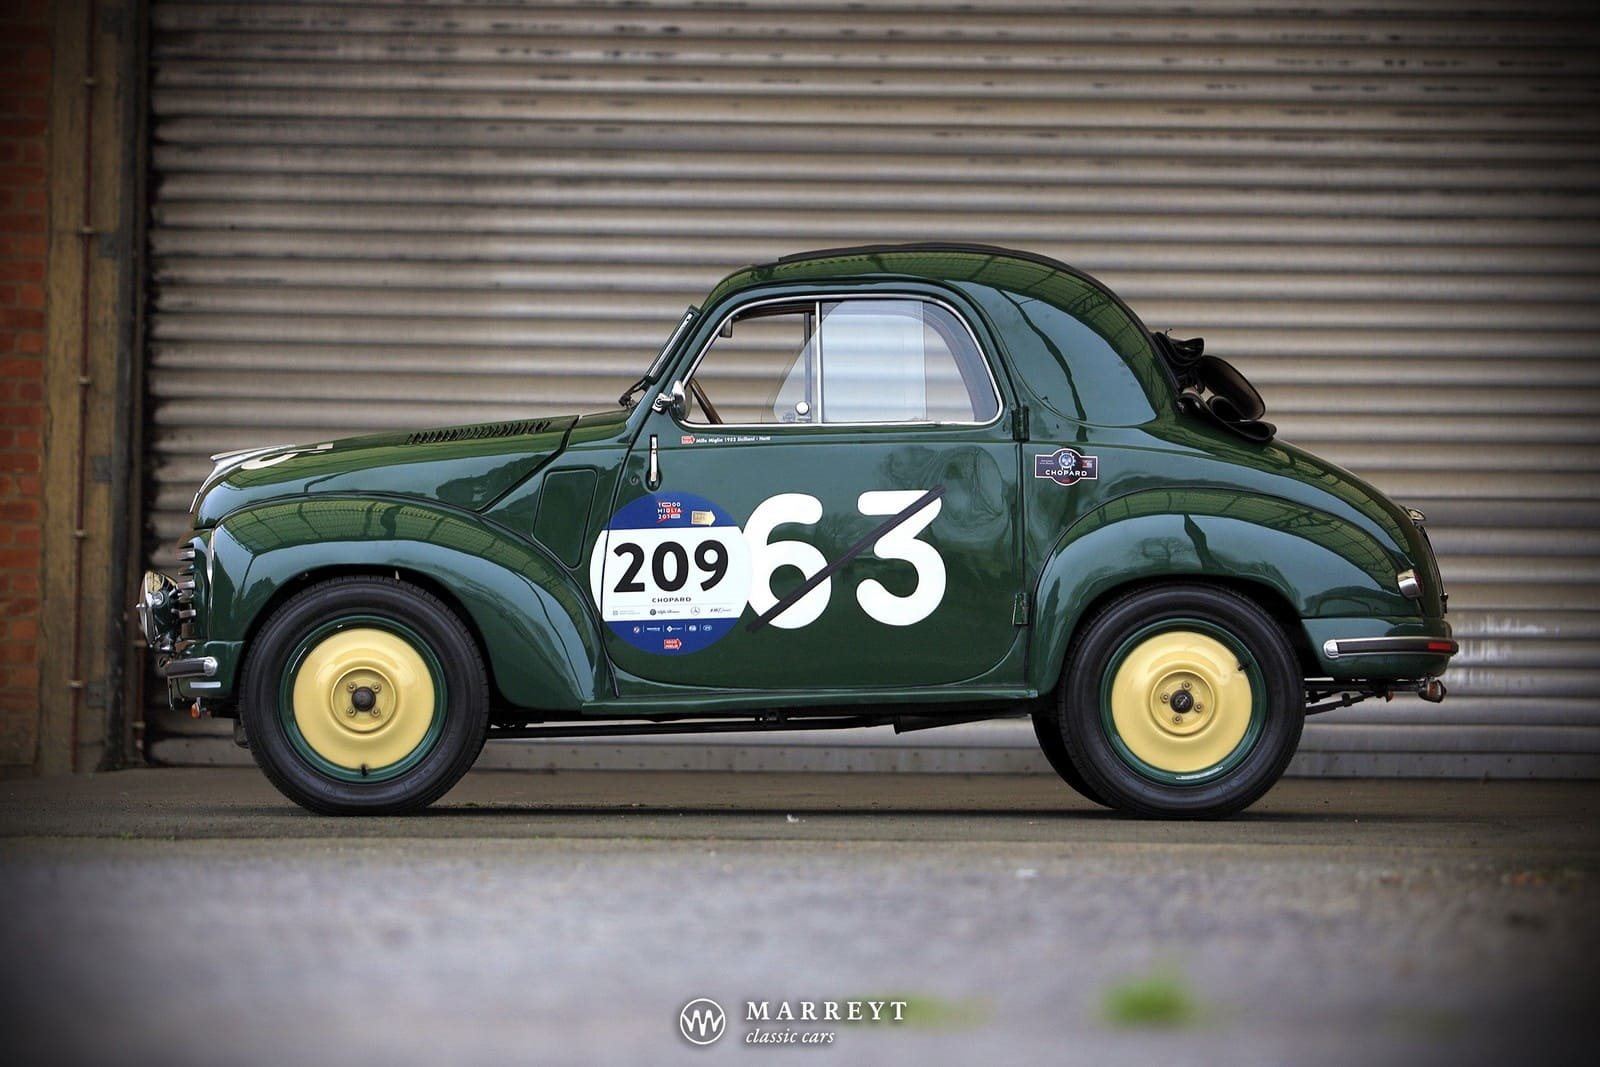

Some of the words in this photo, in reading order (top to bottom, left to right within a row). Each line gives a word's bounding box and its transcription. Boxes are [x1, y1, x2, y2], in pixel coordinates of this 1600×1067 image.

[1045, 469, 1087, 477] CHOPARD
[613, 539, 728, 593] 209
[743, 490, 947, 629] 63
